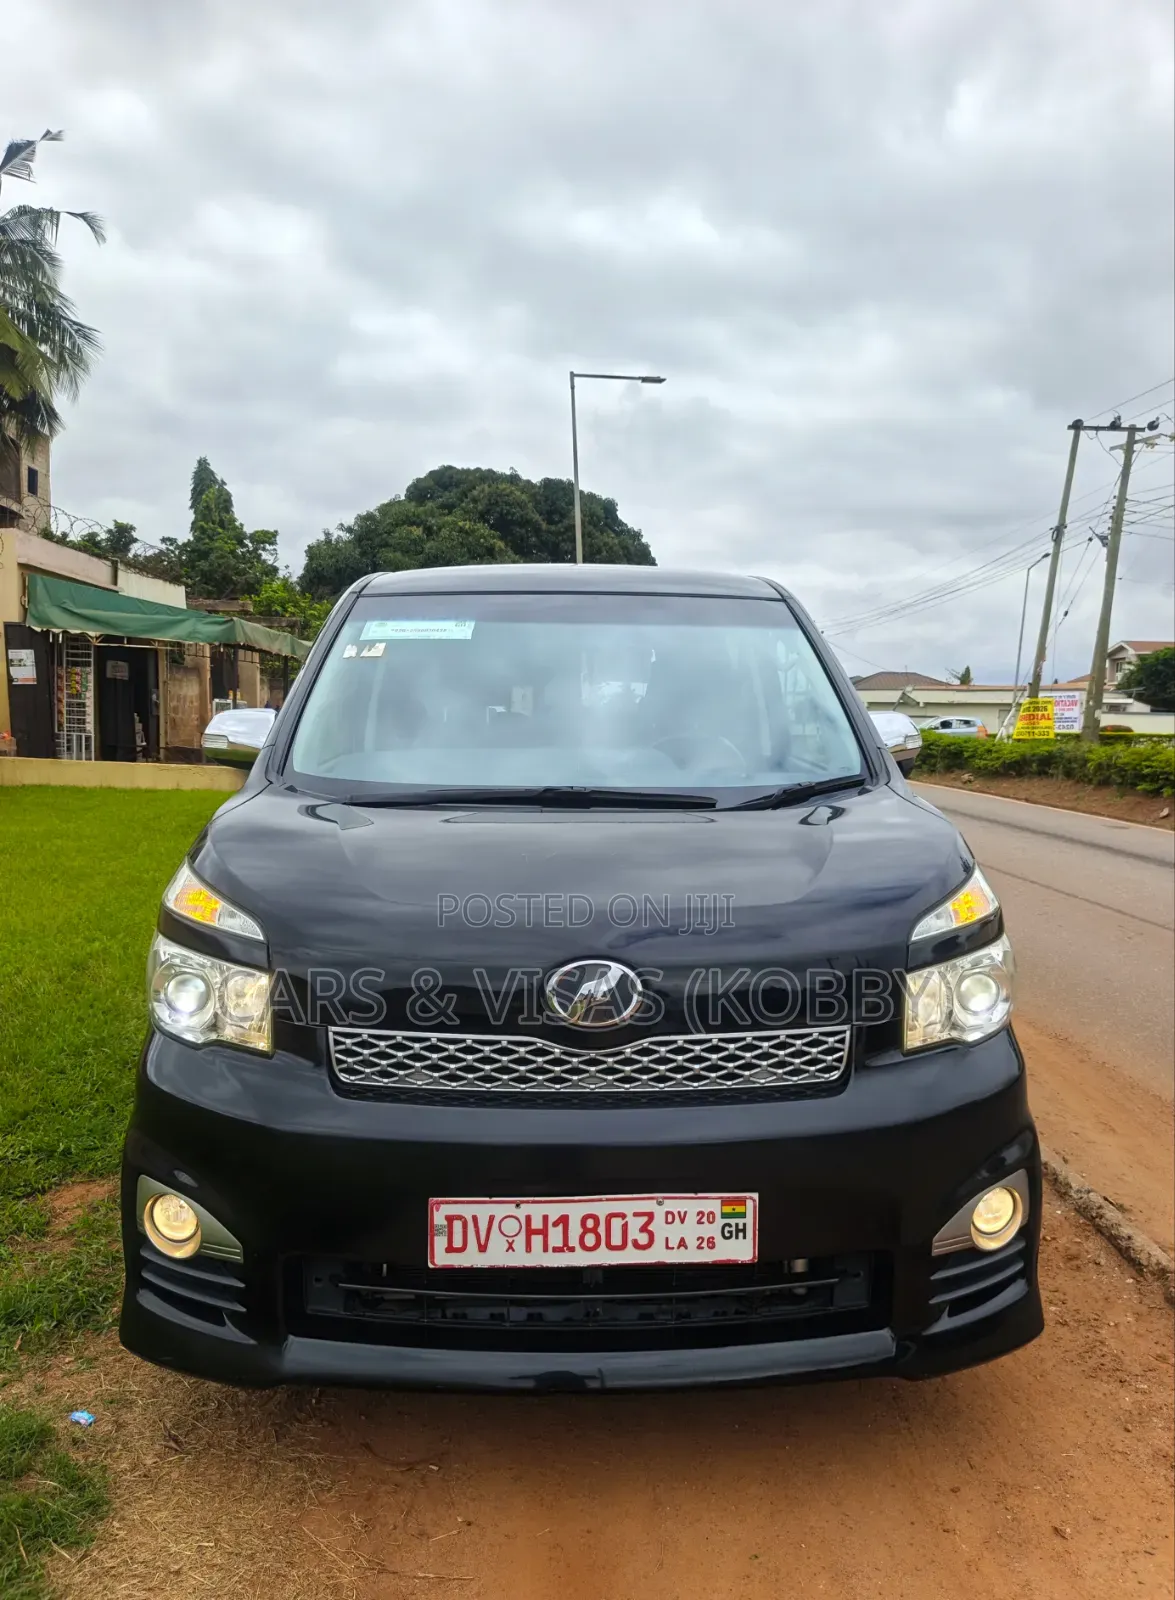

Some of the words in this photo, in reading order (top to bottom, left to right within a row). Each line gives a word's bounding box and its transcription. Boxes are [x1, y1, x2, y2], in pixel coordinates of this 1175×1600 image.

[664, 1210, 688, 1225] DV
[696, 1210, 716, 1225] 20
[525, 1211, 656, 1254] H1803
[720, 1222, 747, 1241] GH
[664, 1236, 689, 1251] LA
[696, 1235, 716, 1250] 26
